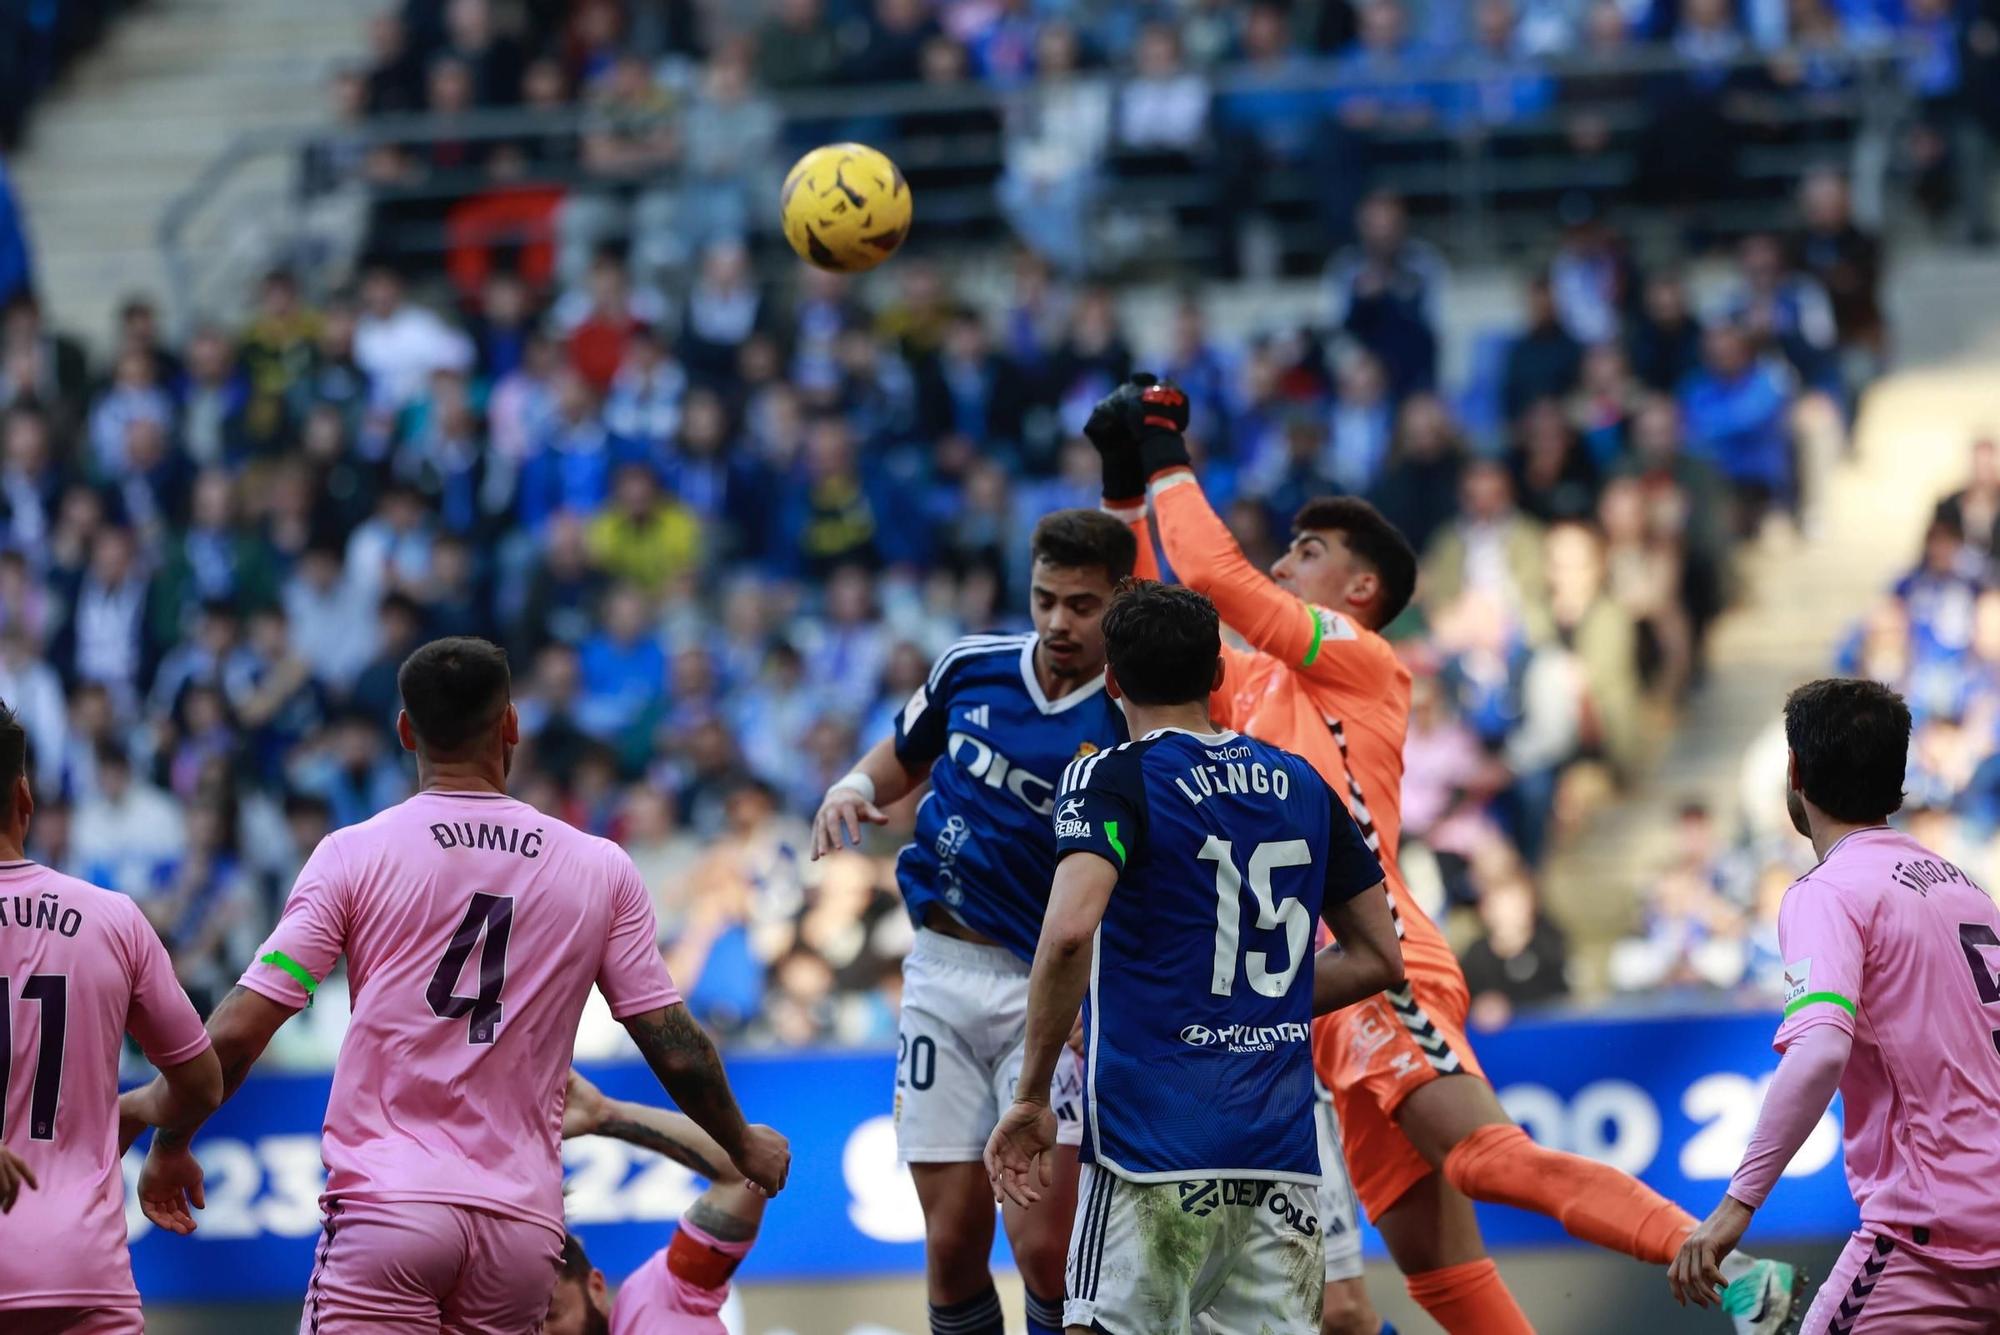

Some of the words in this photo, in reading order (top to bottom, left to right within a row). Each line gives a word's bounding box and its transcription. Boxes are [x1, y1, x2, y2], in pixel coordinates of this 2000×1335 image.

[1175, 762, 1289, 805] LUENGO
[430, 822, 543, 858] ĐUMIĆ
[1197, 834, 1312, 998] 15
[425, 891, 515, 1045] 4
[1217, 1022, 1309, 1046] HYUNDAI
